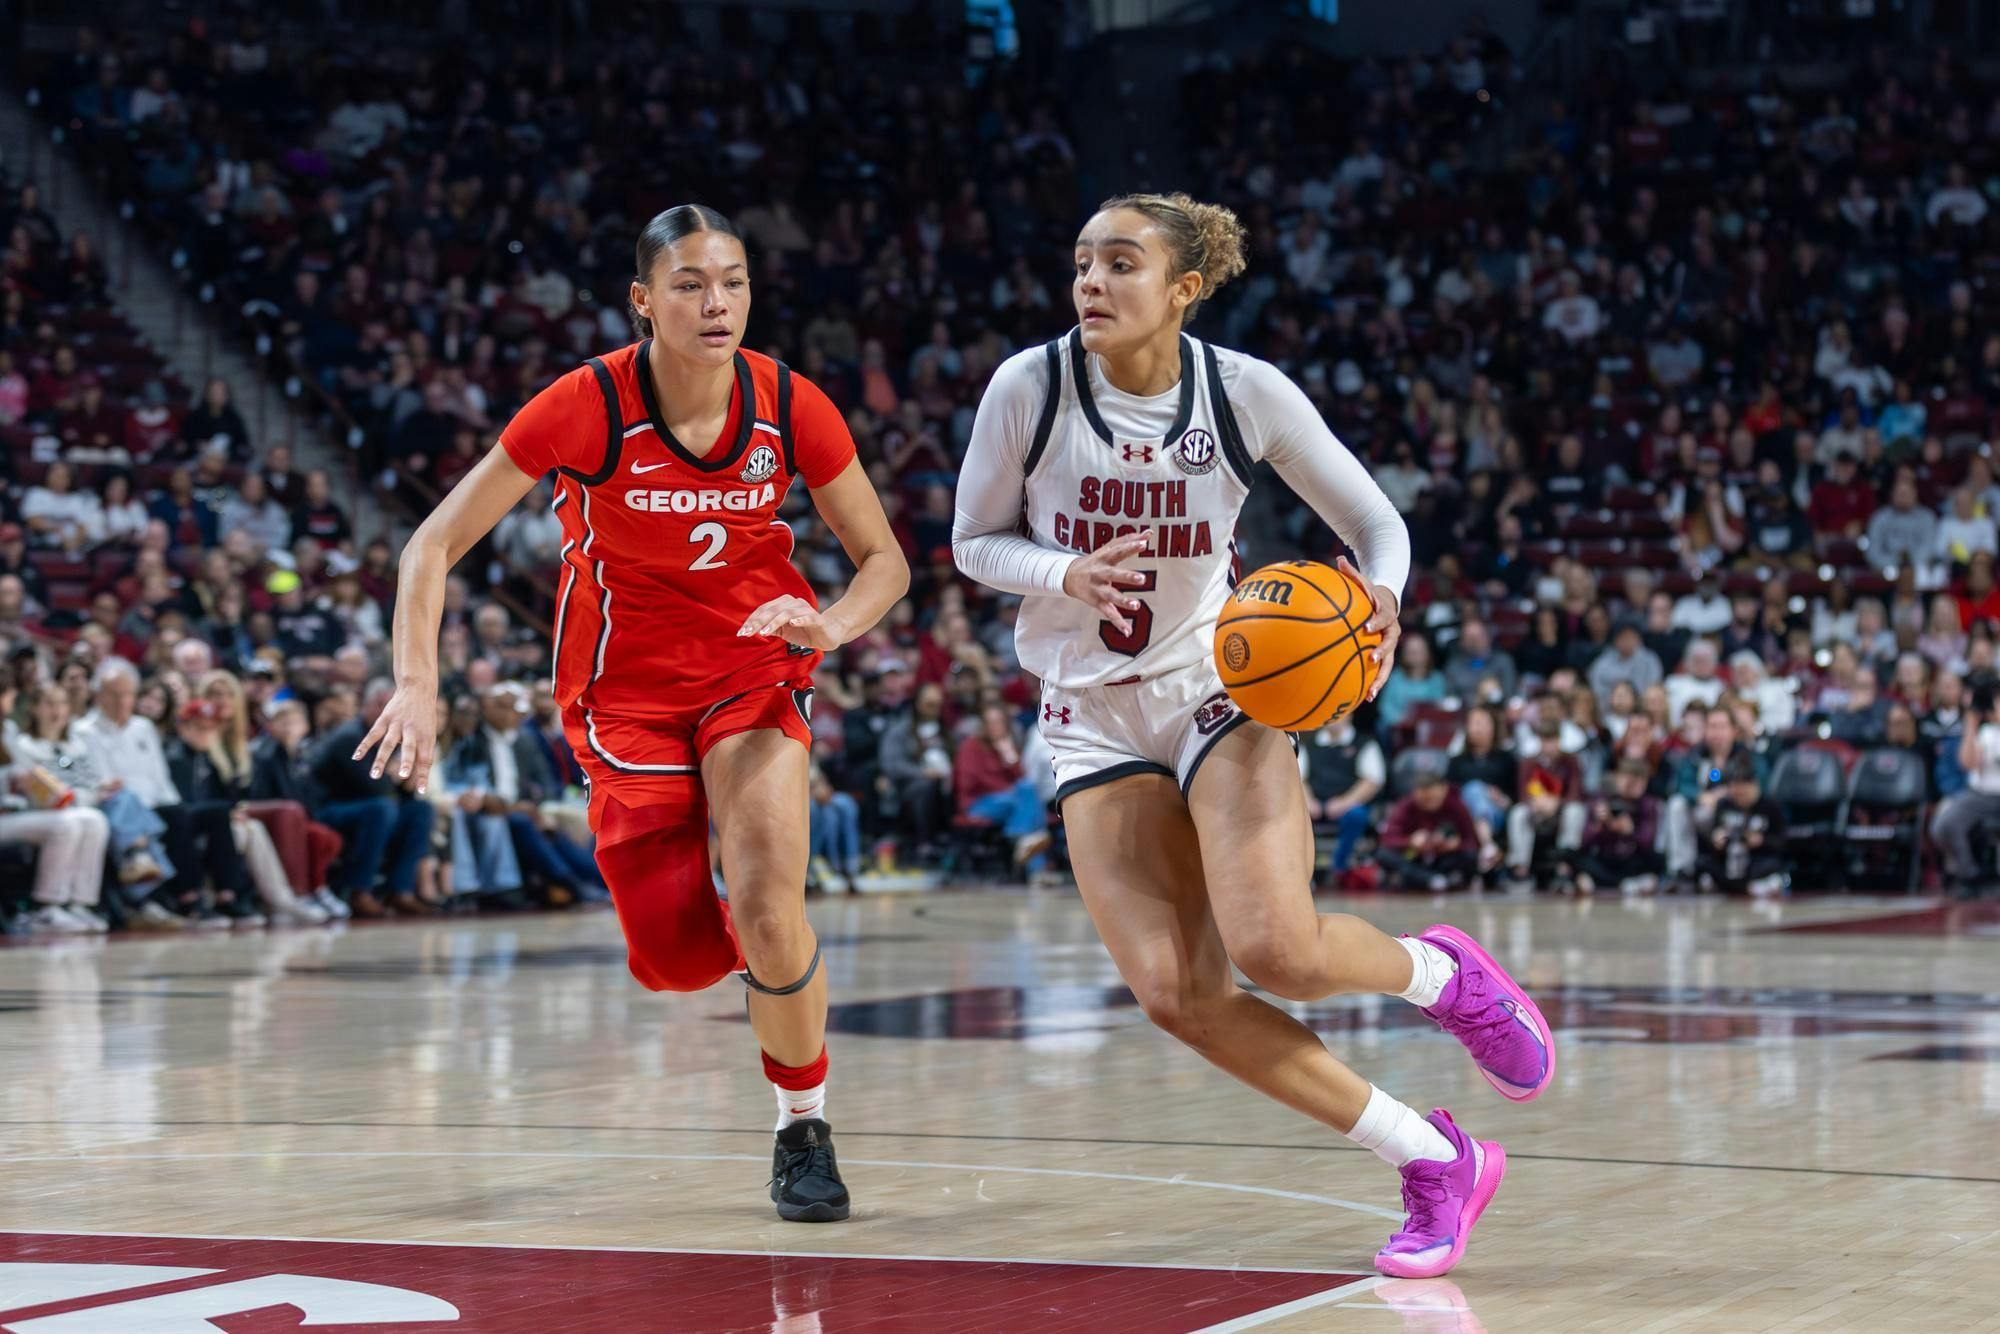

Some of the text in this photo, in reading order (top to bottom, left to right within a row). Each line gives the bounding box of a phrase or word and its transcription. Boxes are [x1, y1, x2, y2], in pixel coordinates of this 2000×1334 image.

[748, 447, 774, 476] SEC
[1183, 431, 1213, 464] SEC
[1177, 453, 1216, 474] GRADUATE
[624, 484, 775, 513] GEORGIA
[1079, 475, 1187, 519] SOUTH
[688, 521, 729, 571] 2
[1234, 579, 1293, 606] Wil
[1099, 570, 1158, 658] 5
